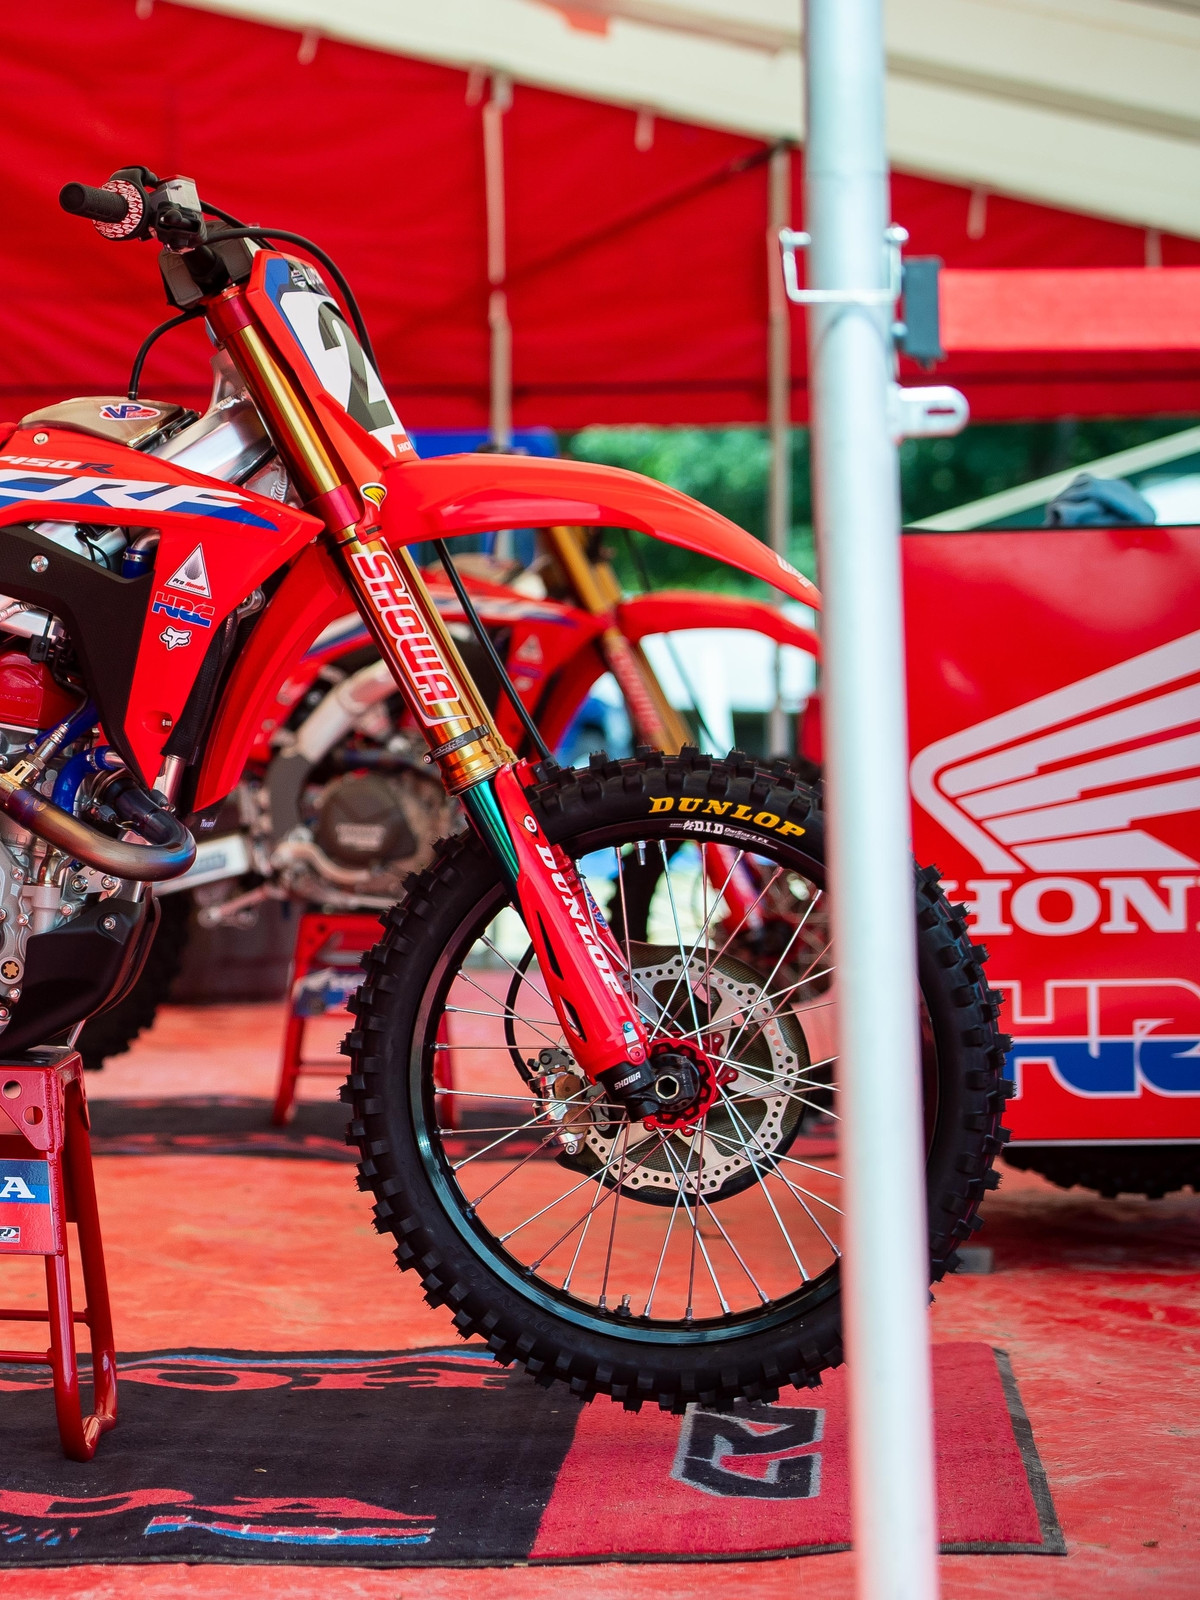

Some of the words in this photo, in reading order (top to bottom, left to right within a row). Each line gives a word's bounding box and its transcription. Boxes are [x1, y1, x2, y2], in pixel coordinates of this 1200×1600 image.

[152, 591, 216, 629] HRC
[350, 550, 460, 706] SHOWA
[648, 796, 806, 838] DUNLOP
[535, 843, 624, 997] DUNLOP
[937, 876, 1200, 936] HON
[614, 1072, 642, 1091] SHOWA
